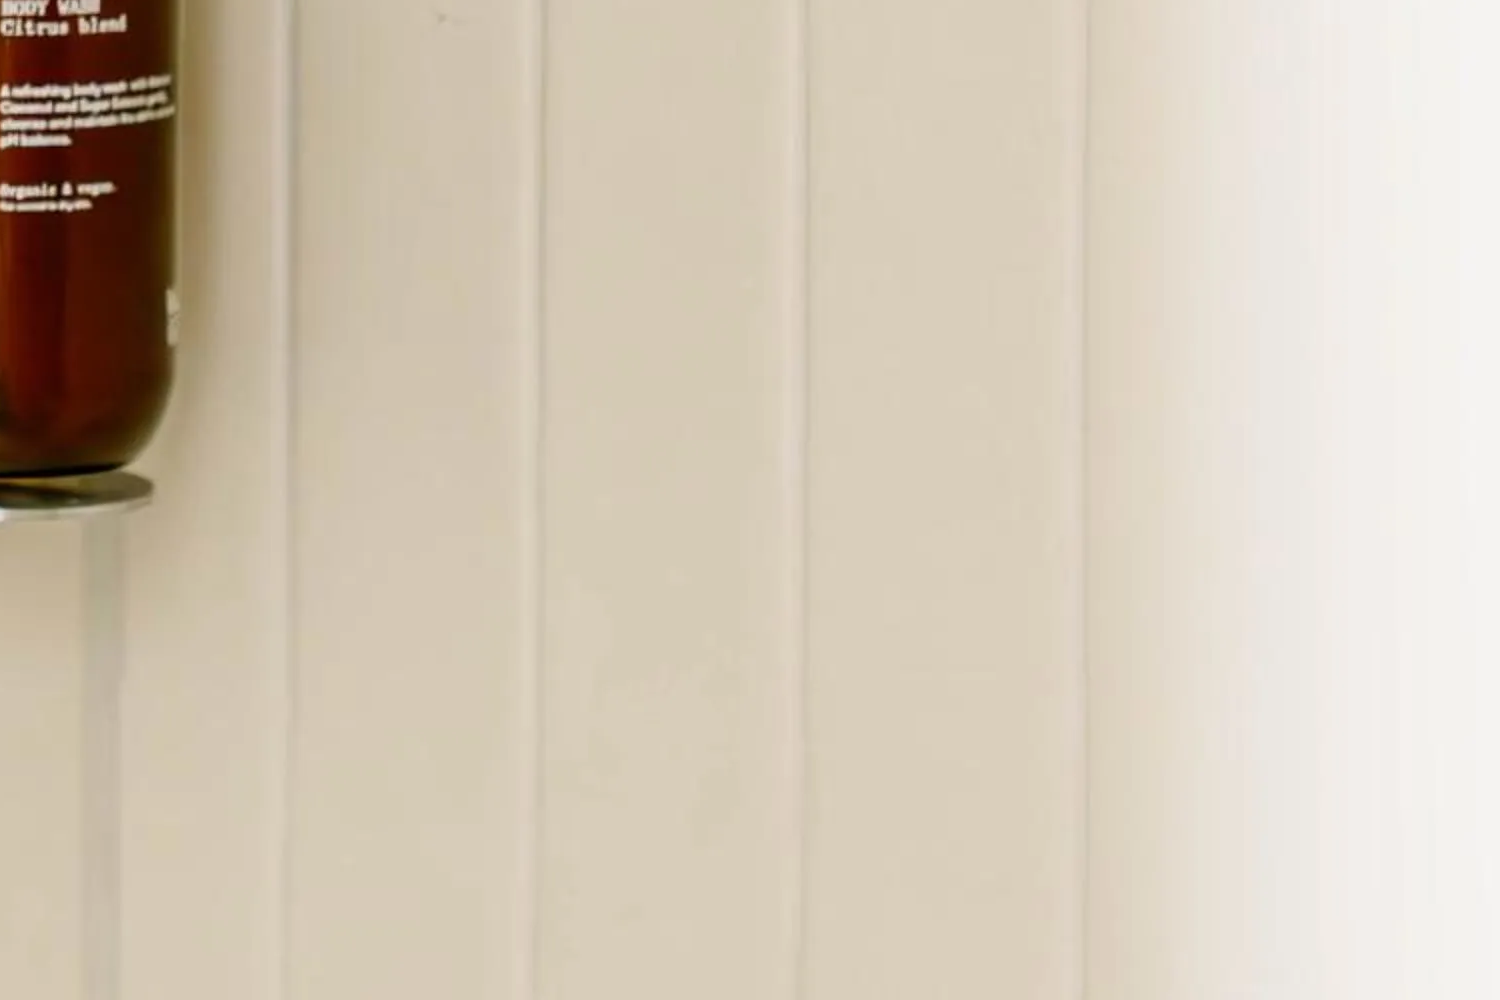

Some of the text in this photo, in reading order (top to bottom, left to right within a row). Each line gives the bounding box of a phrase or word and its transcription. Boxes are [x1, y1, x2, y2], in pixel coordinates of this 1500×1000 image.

[0, 13, 127, 37] Citrus blend
[0, 182, 57, 201] Organic
